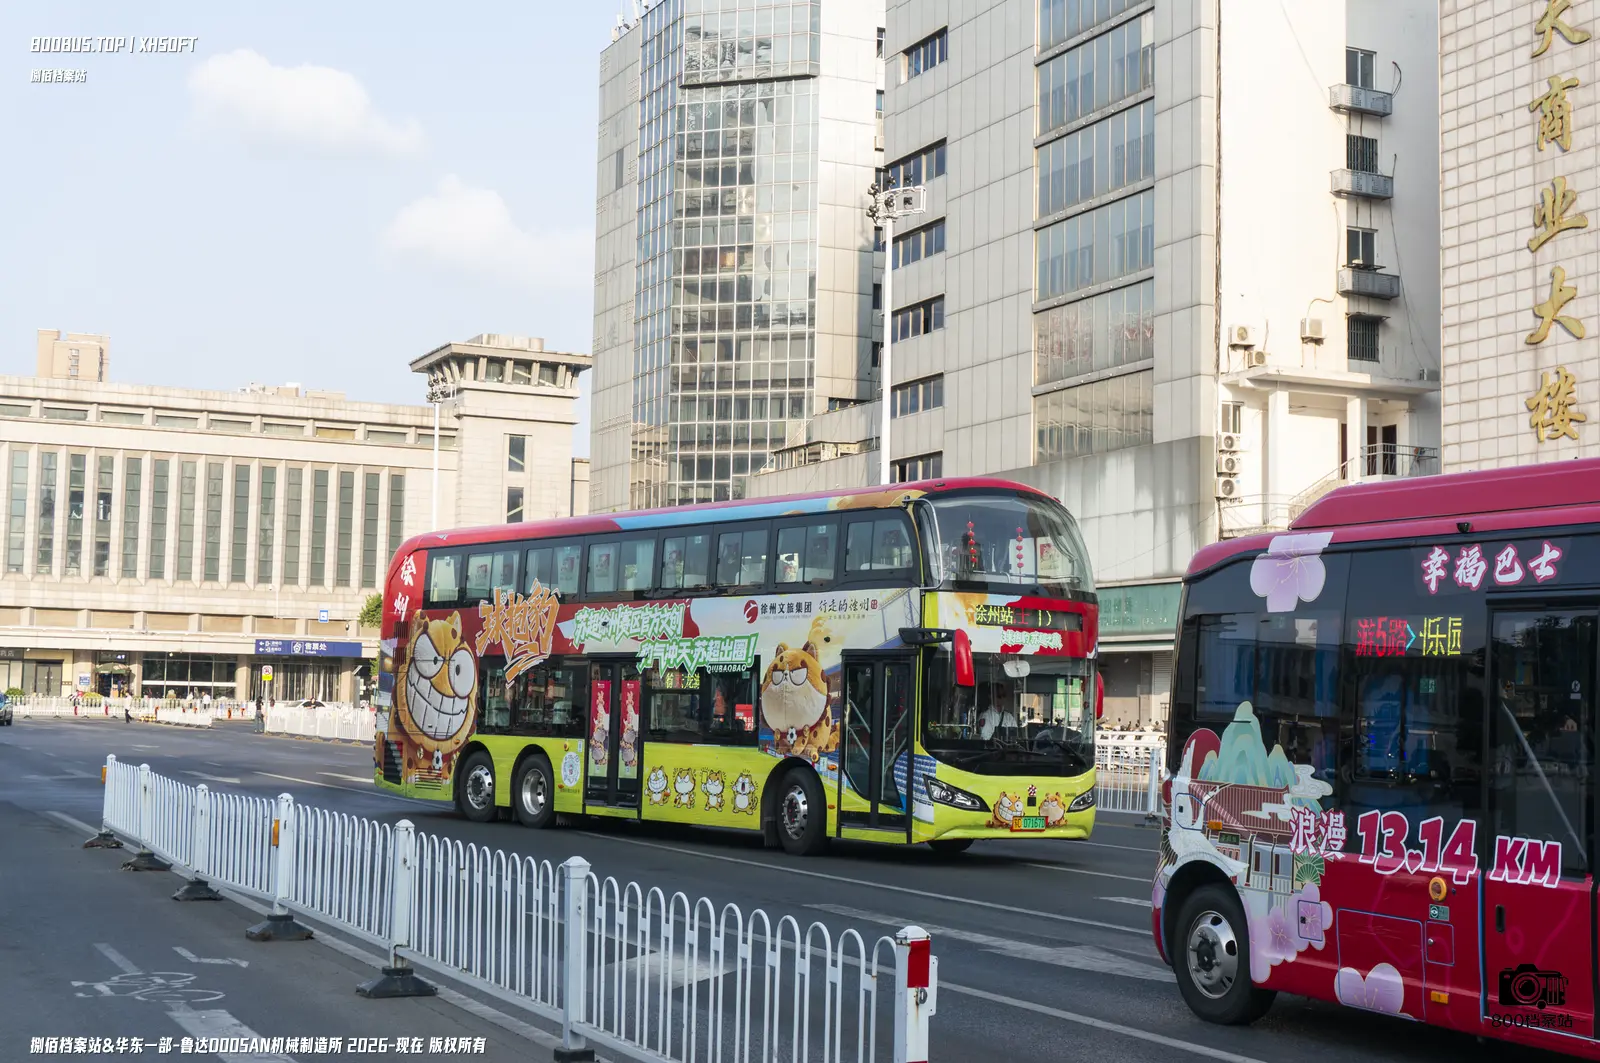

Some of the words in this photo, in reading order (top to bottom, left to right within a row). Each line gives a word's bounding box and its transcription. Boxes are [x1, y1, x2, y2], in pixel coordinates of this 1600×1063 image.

[1421, 541, 1562, 593] 幸福巴士
[760, 601, 812, 615] 徐州文旅集团
[1356, 616, 1407, 657] 游5路
[706, 664, 747, 674] QIUBAOBAO
[1288, 807, 1347, 858] 浪漫
[1489, 835, 1562, 887] KM
